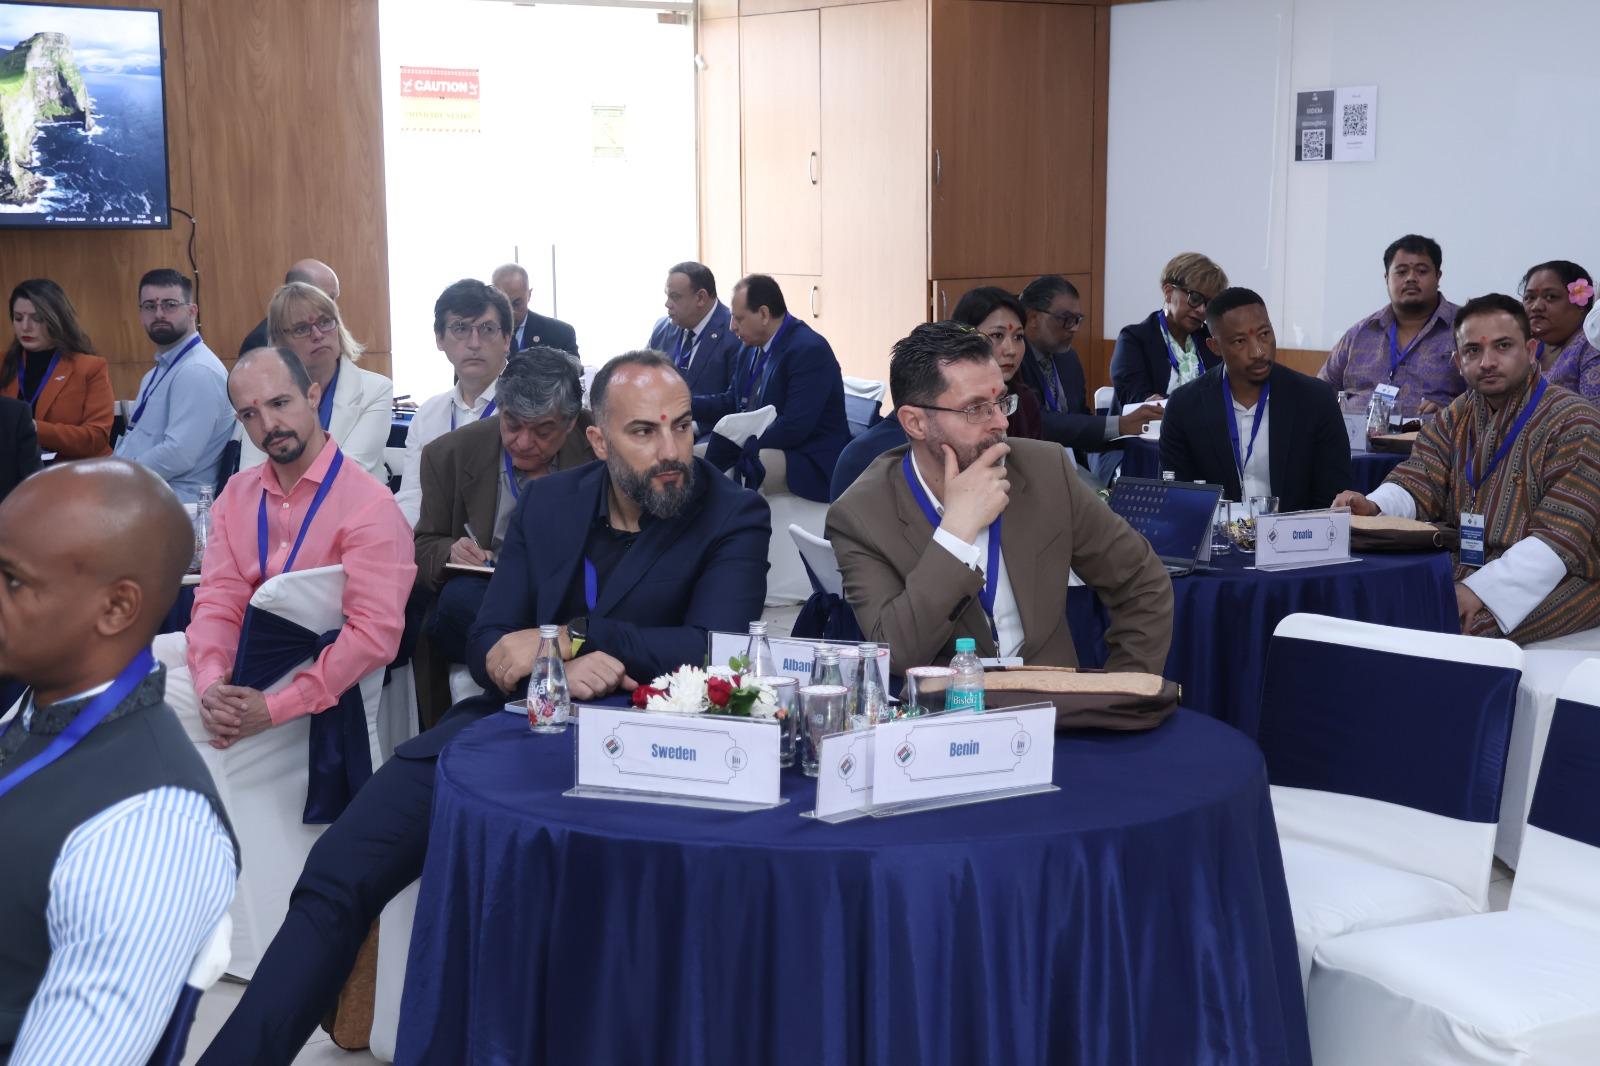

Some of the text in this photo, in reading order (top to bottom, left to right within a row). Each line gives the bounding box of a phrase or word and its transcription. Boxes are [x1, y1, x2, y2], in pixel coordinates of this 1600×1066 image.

[414, 80, 468, 93] CAUTION
[1292, 529, 1313, 540] Croatia
[782, 657, 814, 673] Albani
[651, 743, 697, 762] Sweden
[949, 740, 980, 757] Benin
